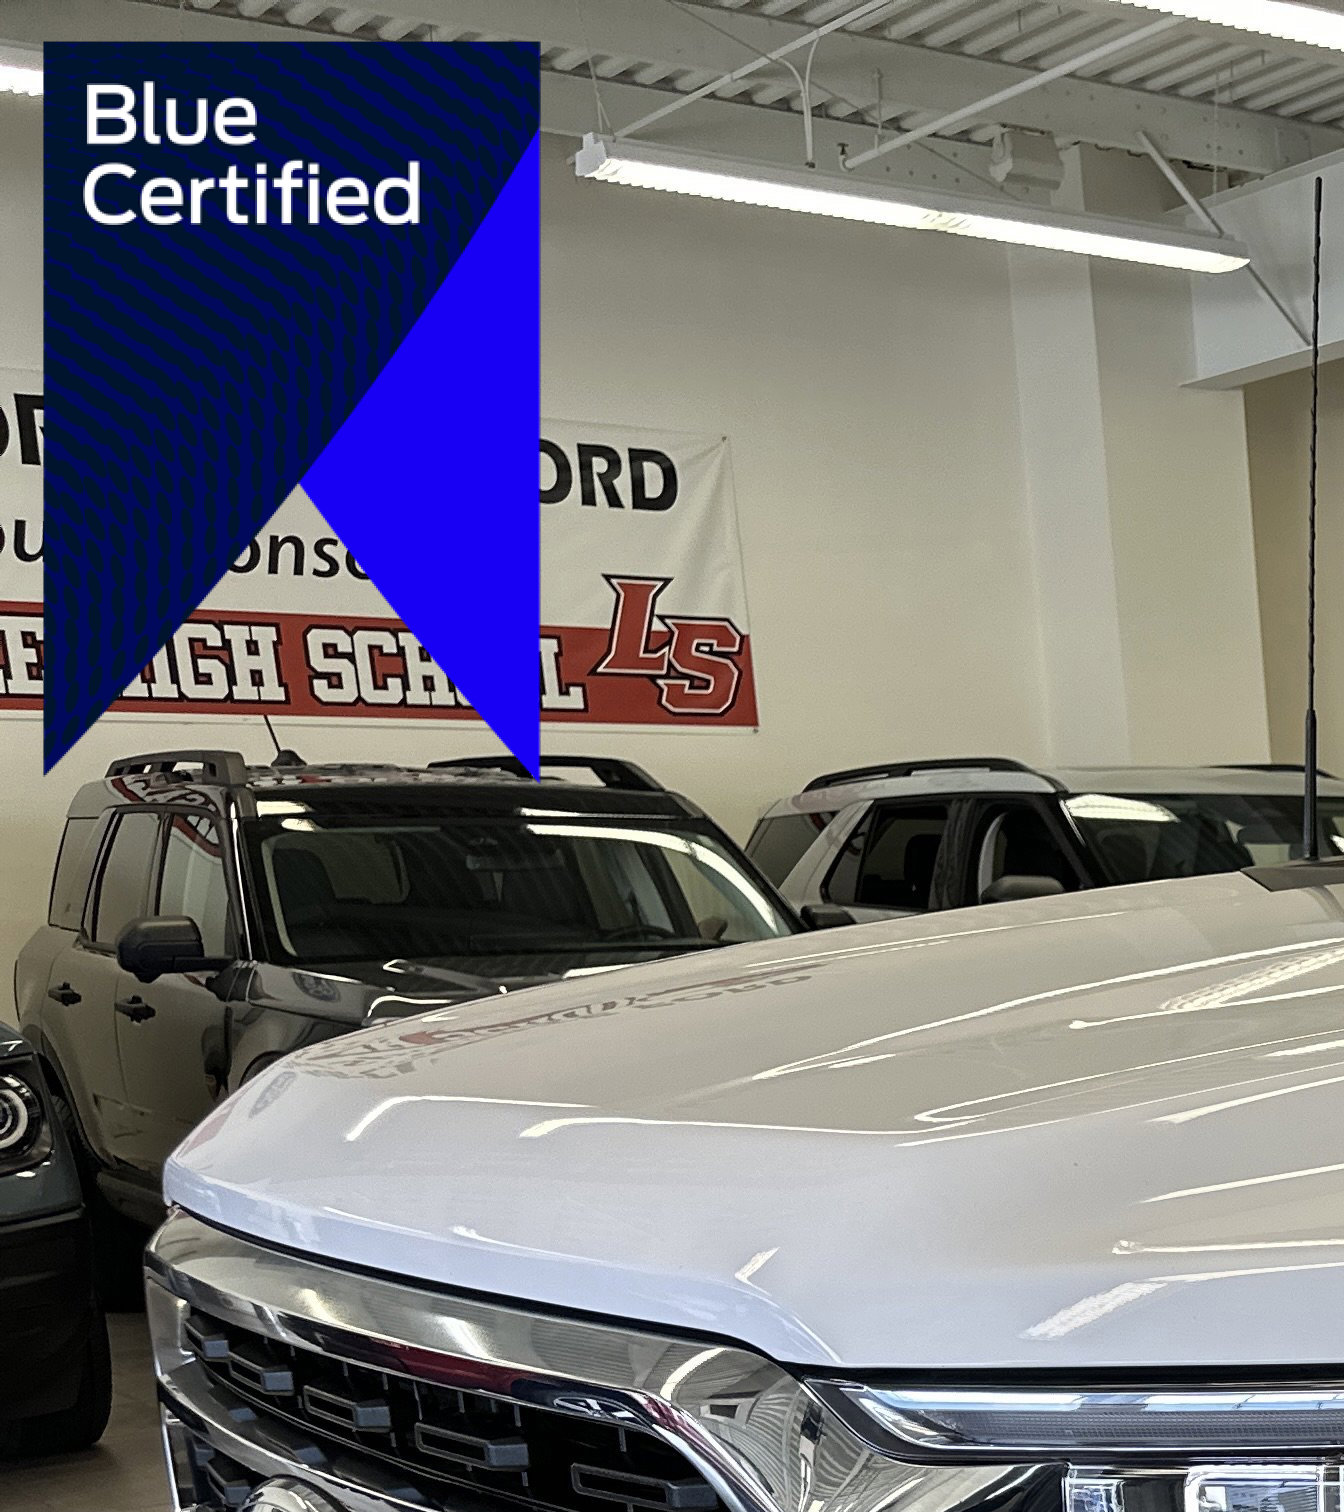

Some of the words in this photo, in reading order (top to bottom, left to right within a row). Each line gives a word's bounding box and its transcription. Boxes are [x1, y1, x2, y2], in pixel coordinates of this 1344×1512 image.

[538, 438, 679, 511] ORD
[122, 619, 290, 704] IGH
[304, 625, 588, 712] SCHL
